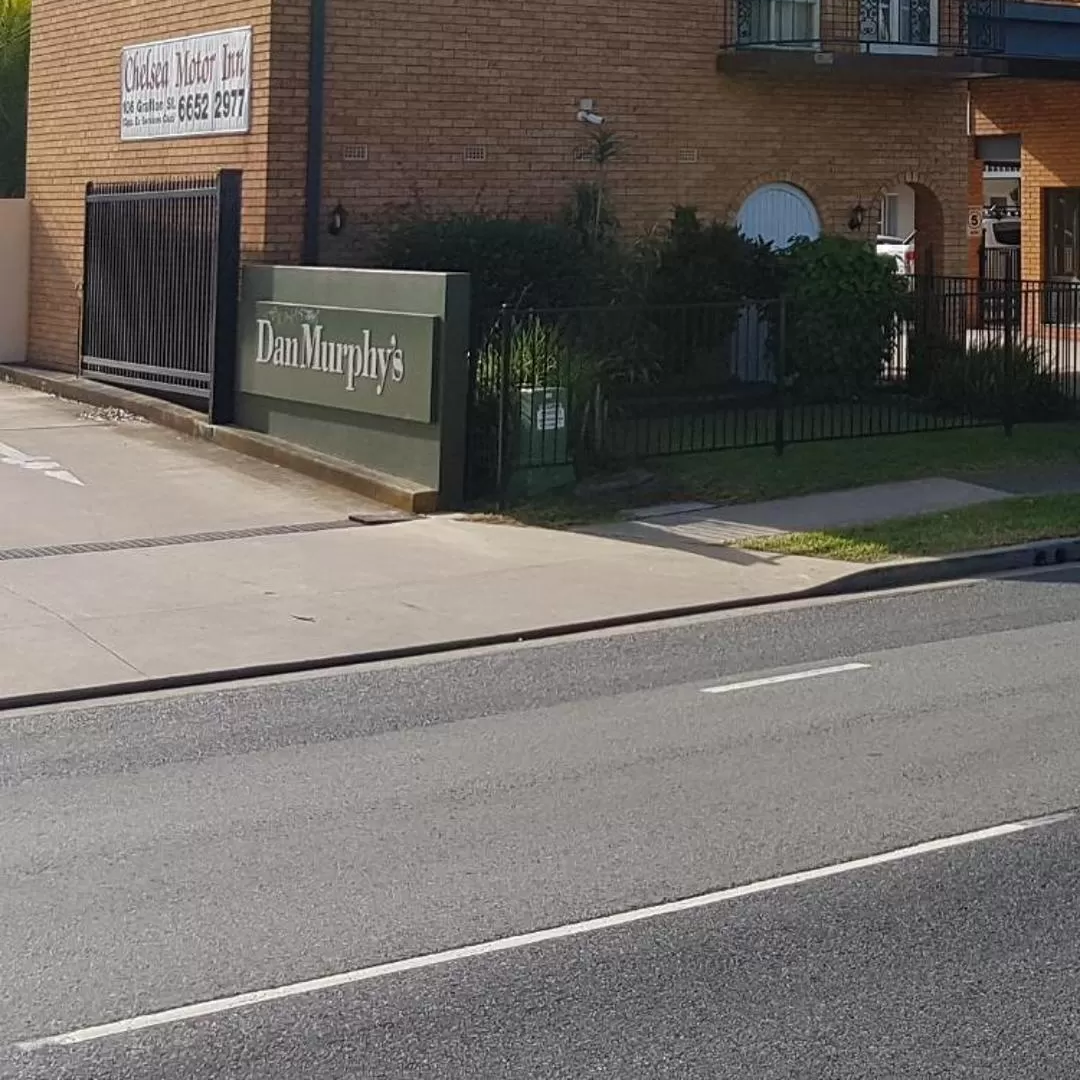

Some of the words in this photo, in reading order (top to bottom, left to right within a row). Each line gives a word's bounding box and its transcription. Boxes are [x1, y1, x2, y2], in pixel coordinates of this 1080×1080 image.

[124, 49, 169, 93] Chelsea
[175, 49, 217, 88] Motor
[221, 43, 246, 82] Inn
[178, 92, 210, 122] 6652
[214, 88, 245, 119] 2977
